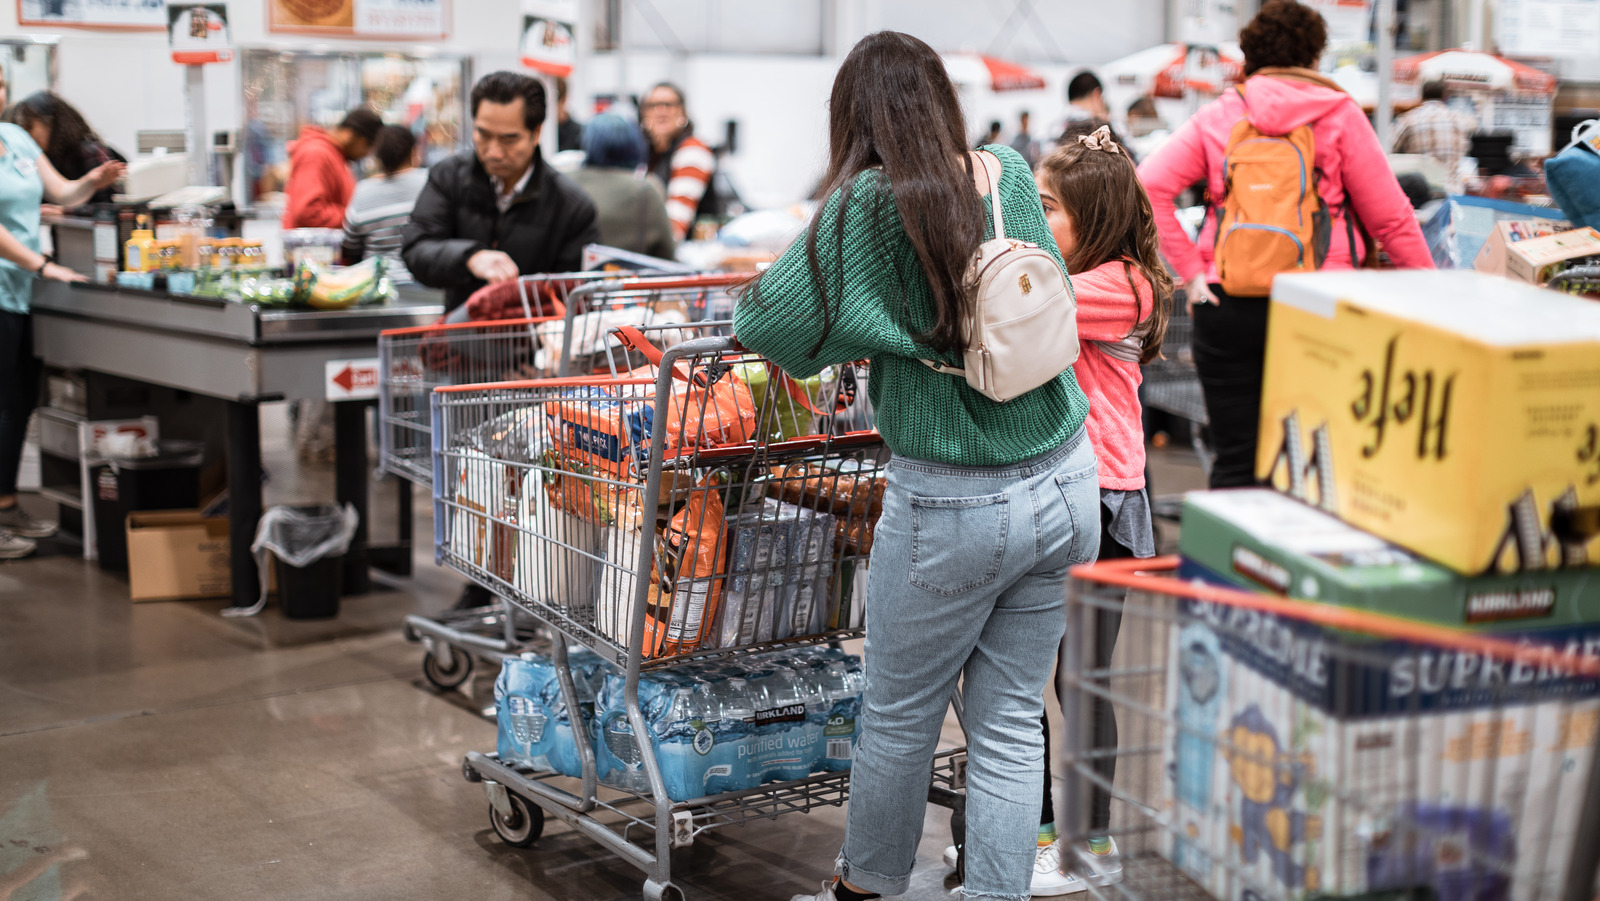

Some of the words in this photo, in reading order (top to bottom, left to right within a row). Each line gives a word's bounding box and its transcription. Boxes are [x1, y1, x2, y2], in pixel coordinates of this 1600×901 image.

[1467, 590, 1554, 614] KIRKLAND
[757, 705, 804, 720] KIRKLAND
[827, 716, 844, 726] 40
[738, 735, 783, 759] purified
[788, 731, 819, 749] water
